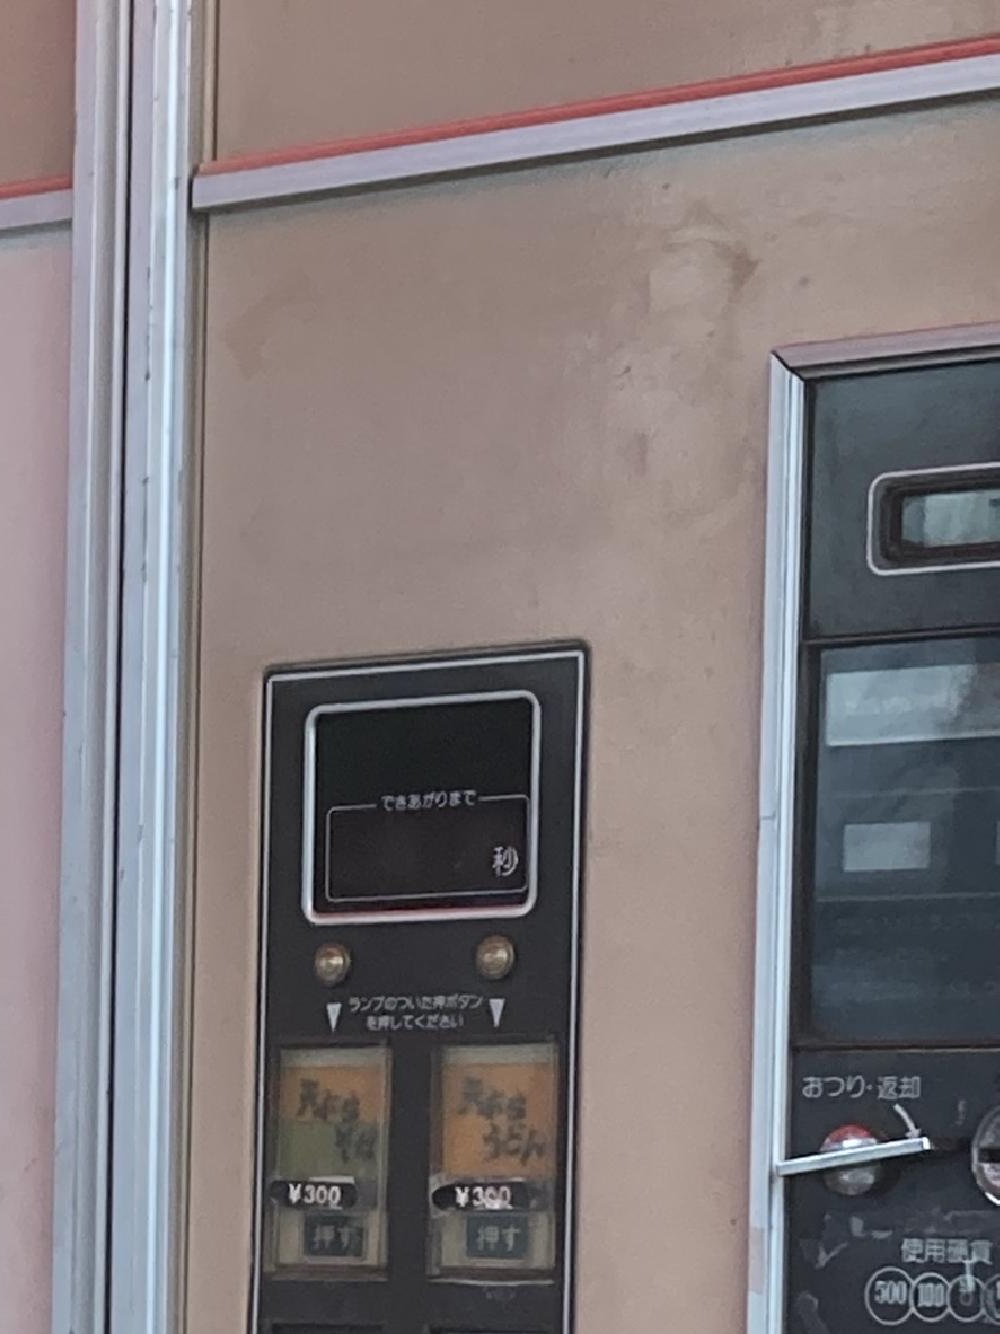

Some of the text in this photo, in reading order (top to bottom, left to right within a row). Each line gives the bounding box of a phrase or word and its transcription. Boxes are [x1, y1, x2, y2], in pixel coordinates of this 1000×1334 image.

[381, 790, 476, 812] できあがりまで
[492, 846, 519, 877] 秒
